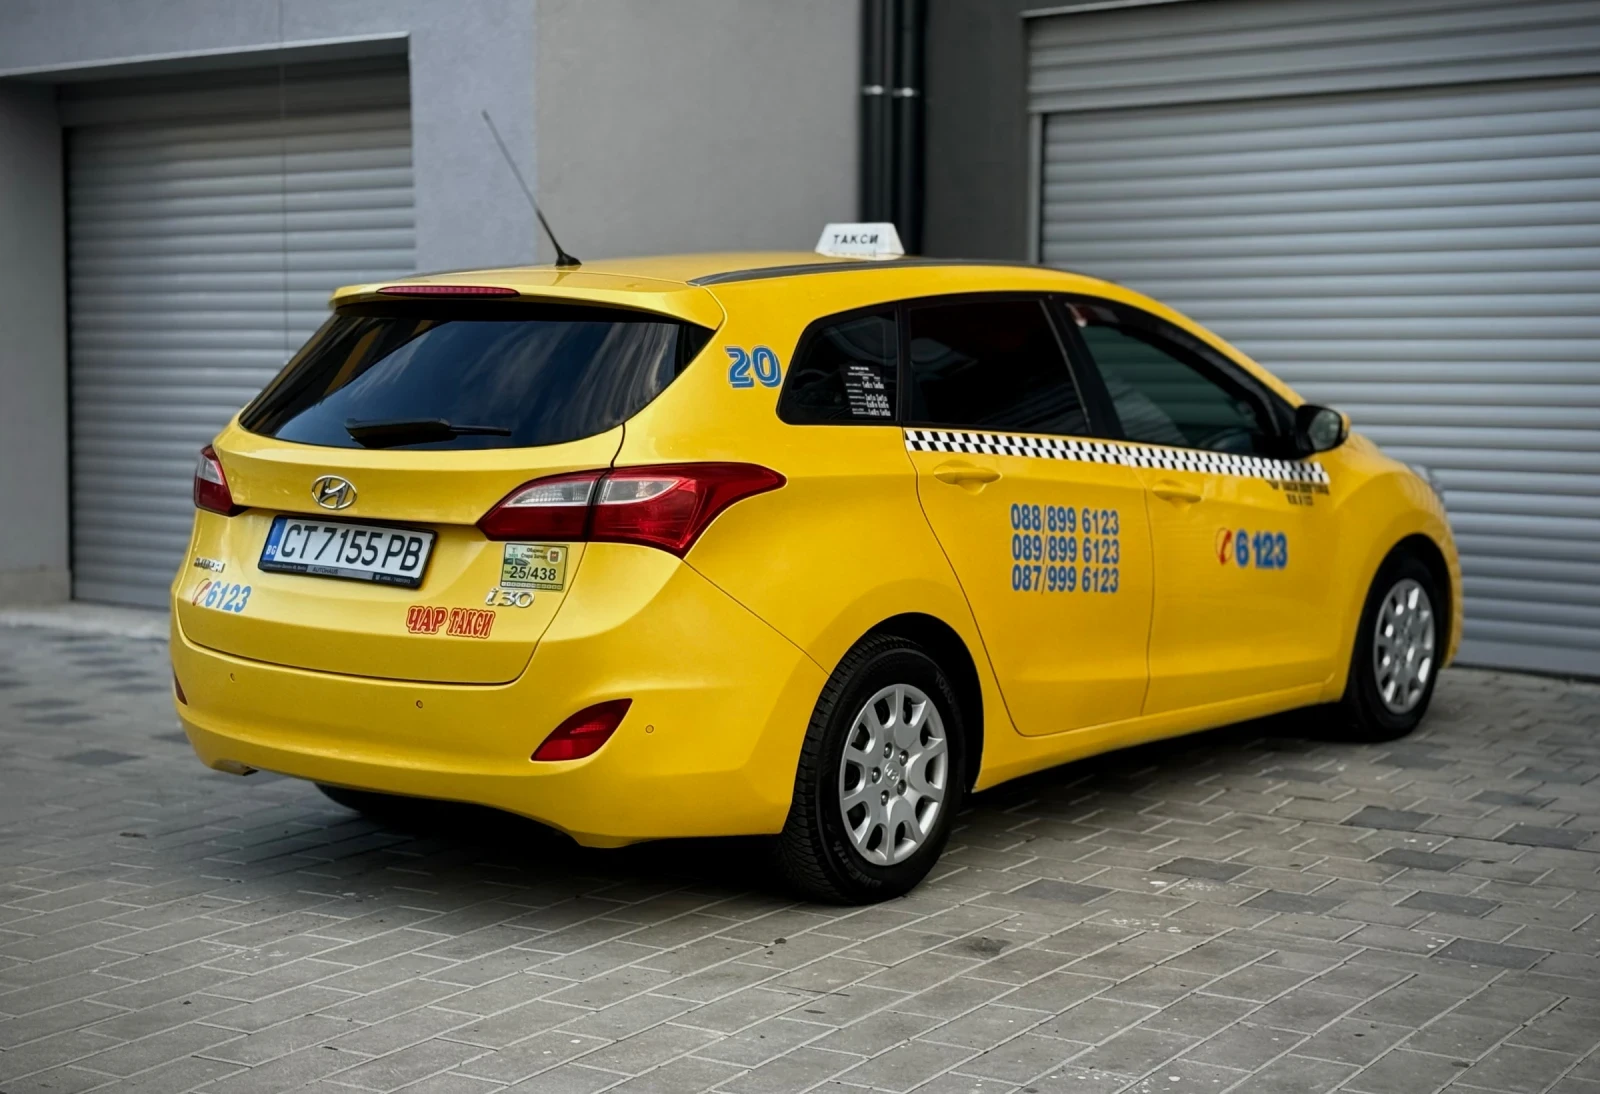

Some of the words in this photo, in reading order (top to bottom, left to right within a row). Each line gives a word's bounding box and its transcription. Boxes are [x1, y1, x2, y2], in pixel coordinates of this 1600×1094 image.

[833, 234, 879, 244] ТАКСИ
[726, 345, 782, 388] 20
[1010, 503, 1077, 535] 088/899
[1082, 508, 1119, 536] 6123
[266, 545, 277, 555] BG
[281, 524, 319, 559] CT
[314, 527, 384, 567] 7155
[1012, 533, 1077, 565] 089/899
[1083, 537, 1120, 564] 6123
[510, 565, 557, 581] 25/438
[1012, 563, 1077, 595] 087/999
[1082, 566, 1119, 593] 6123
[205, 580, 252, 613] 6123
[406, 606, 448, 634] ЧАР
[447, 608, 495, 638] ТАКСИ
